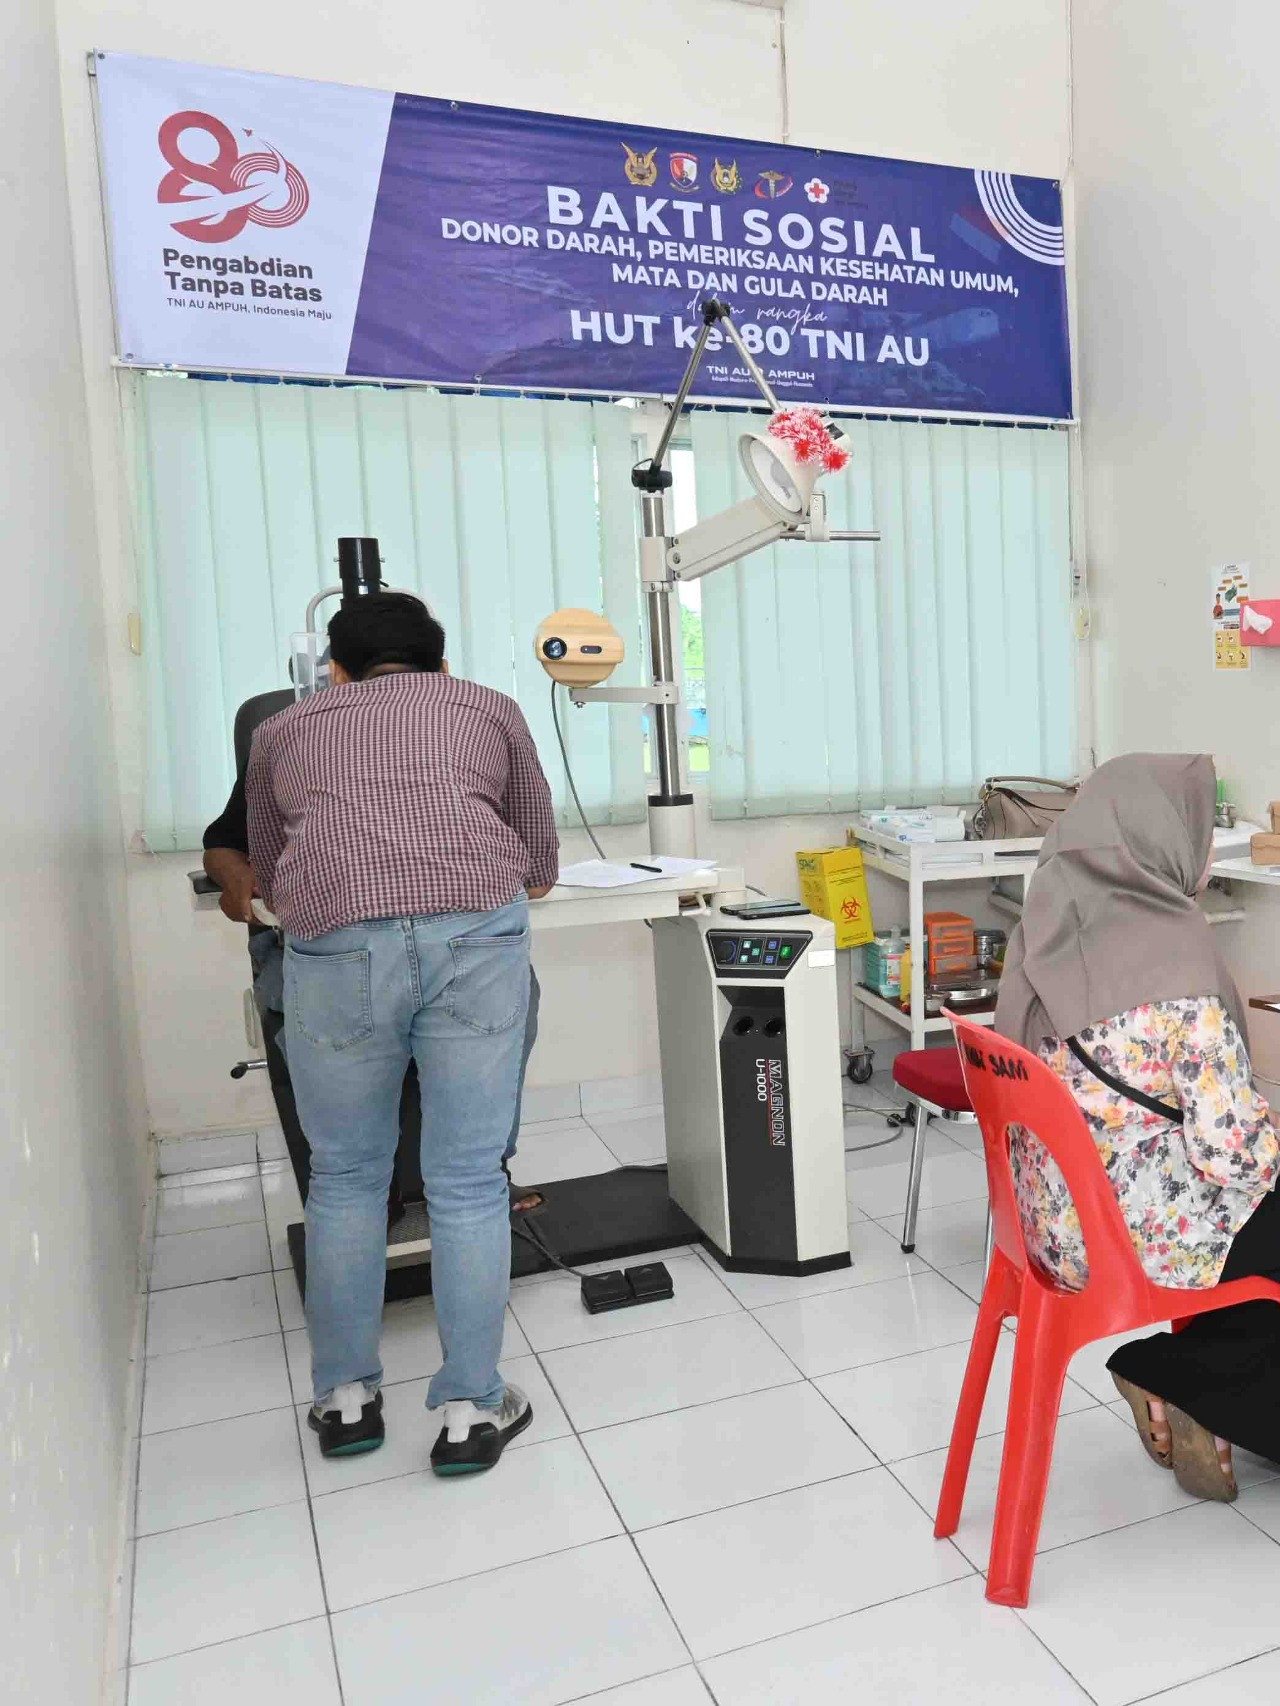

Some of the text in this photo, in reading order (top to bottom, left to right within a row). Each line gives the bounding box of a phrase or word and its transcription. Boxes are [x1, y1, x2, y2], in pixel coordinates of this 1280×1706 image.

[547, 185, 935, 263] BAKTI SOSIAL
[162, 248, 313, 280] Pengabdian
[441, 217, 1019, 297] DONOR DARAH, PEMERIKSAAN KESEHATAN UMUM,
[165, 271, 323, 303] Tanpa Batas
[612, 263, 888, 306] MATA DAN GULA DARAH
[167, 298, 186, 308] TNI
[188, 300, 205, 310] AU
[253, 305, 305, 317] Indonesia
[308, 308, 332, 321] Maju
[757, 303, 828, 335] rangka
[570, 309, 660, 347] HUT
[800, 328, 865, 362] TNI
[877, 335, 930, 367] AU
[706, 365, 728, 375] TNI
[768, 369, 815, 380] AMPUH
[756, 1058, 767, 1102] U-1000
[769, 1059, 786, 1146] MAGNON
